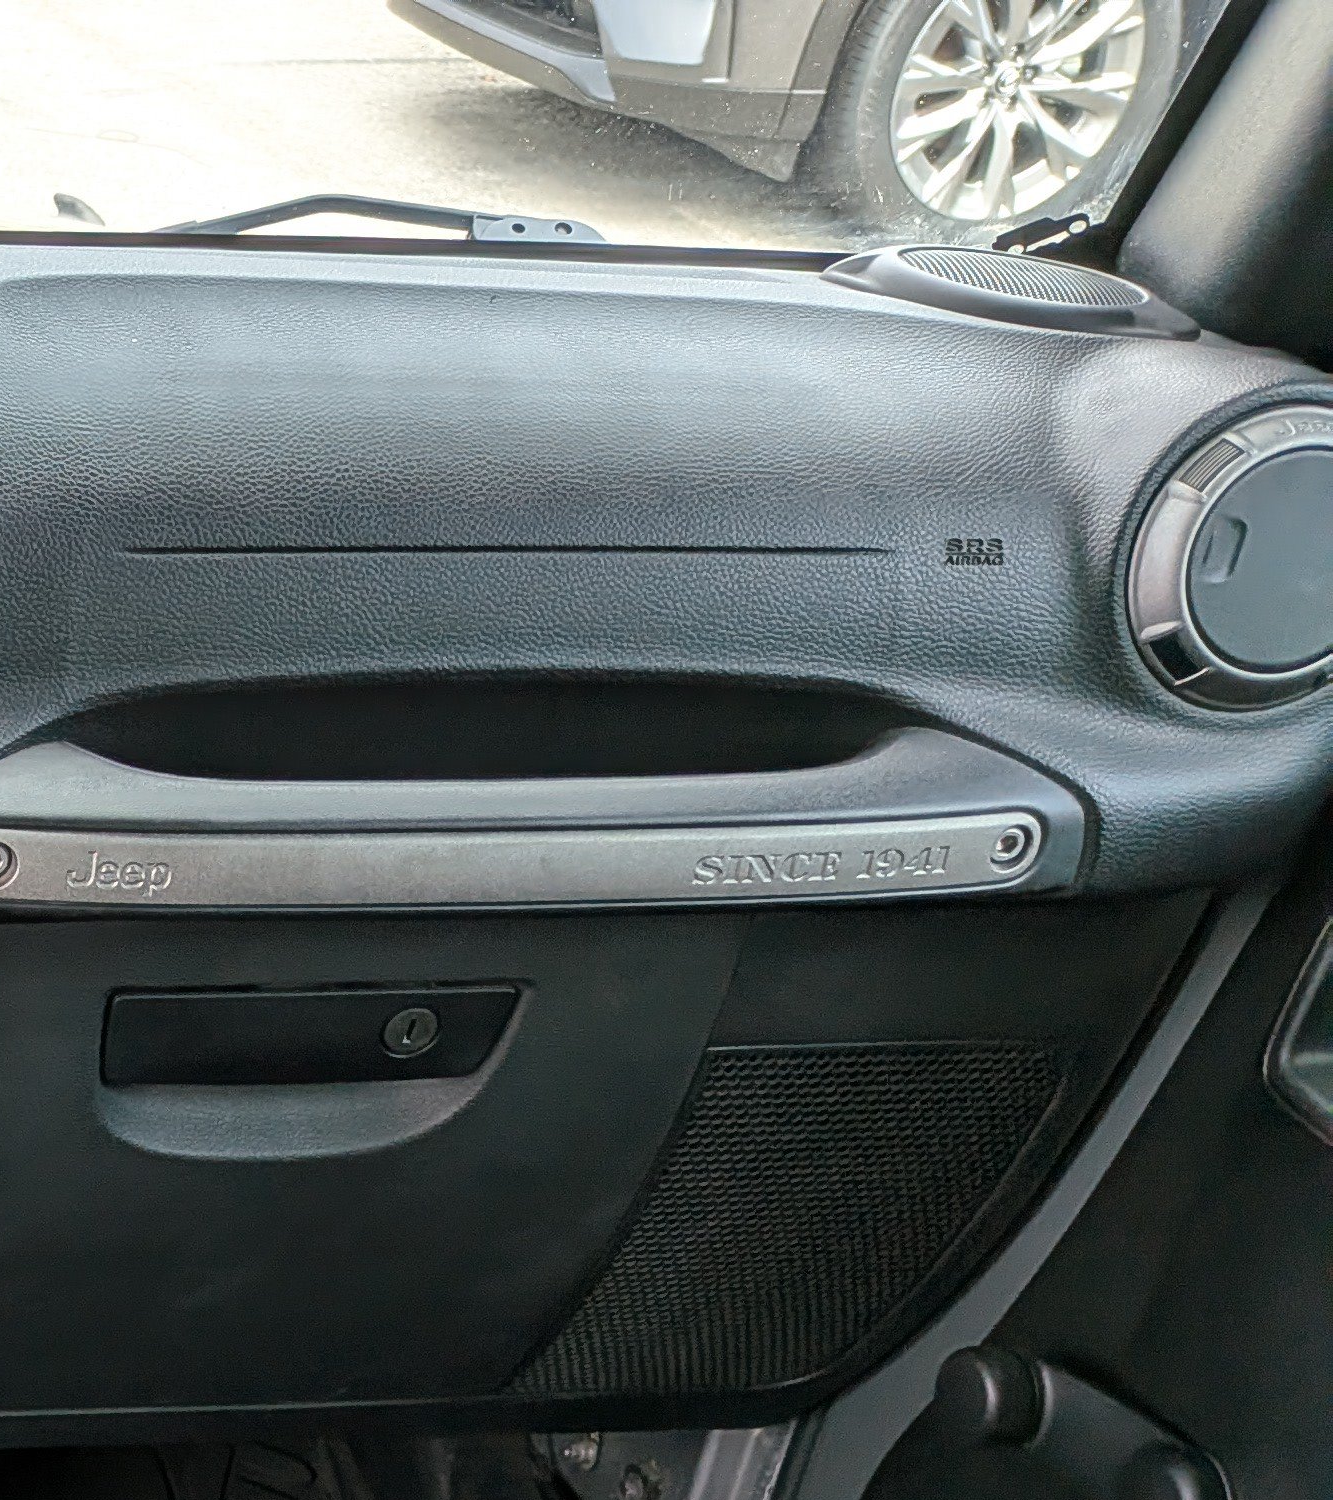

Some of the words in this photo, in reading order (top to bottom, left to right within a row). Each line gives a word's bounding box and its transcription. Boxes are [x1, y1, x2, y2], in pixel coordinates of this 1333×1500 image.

[945, 538, 1003, 553] SRS
[65, 850, 173, 897] Jeep
[692, 851, 843, 886] SINCE
[857, 845, 951, 880] 1941
